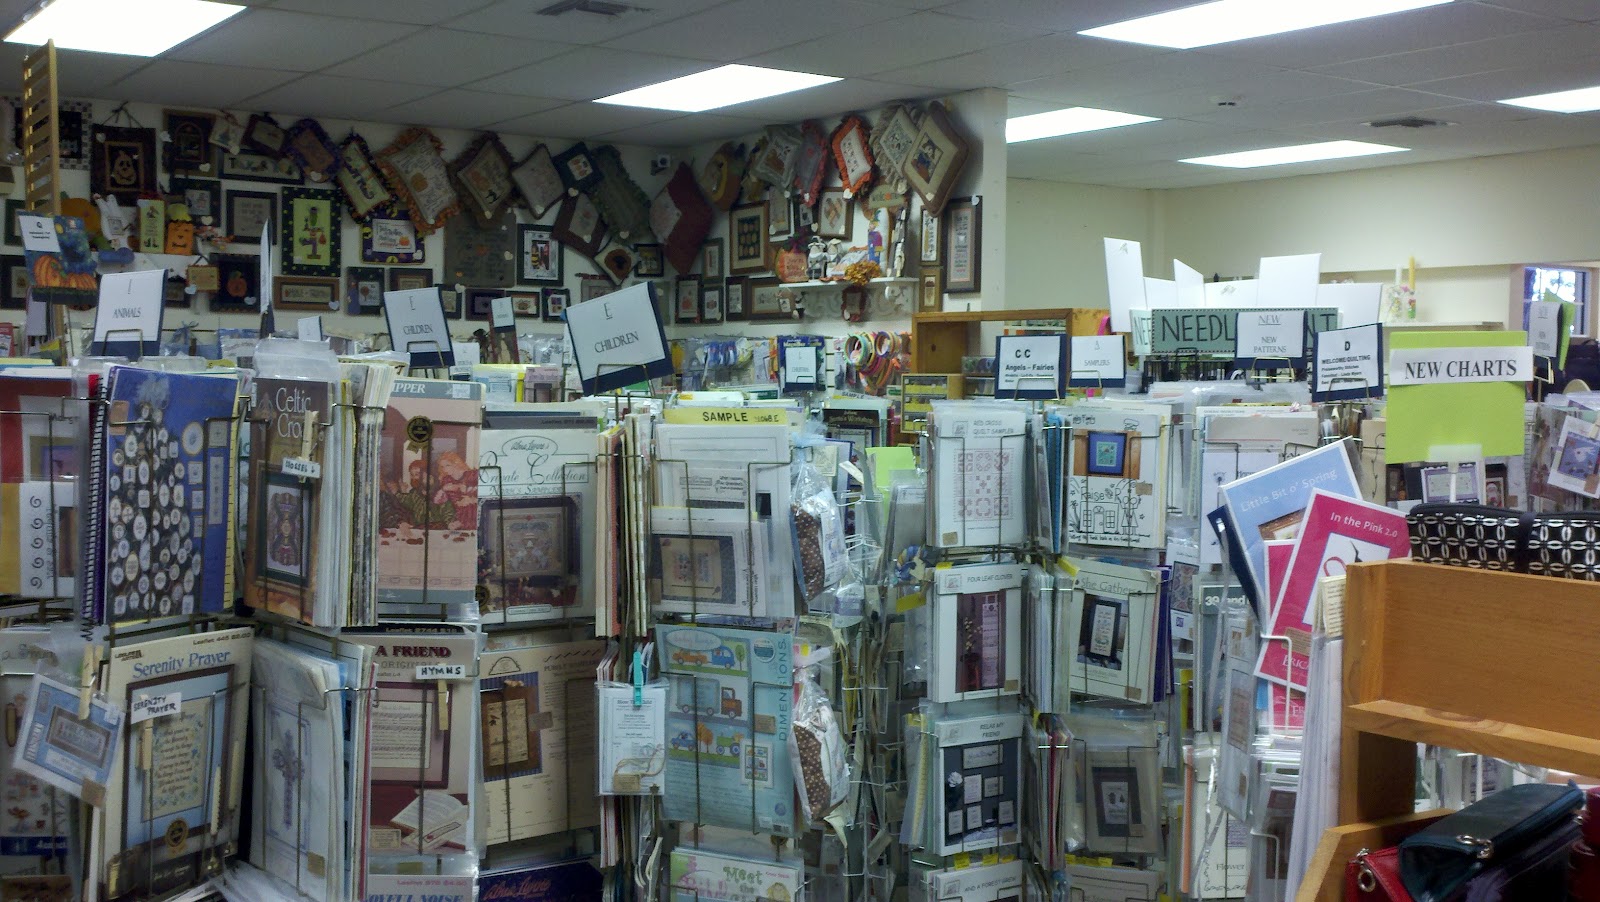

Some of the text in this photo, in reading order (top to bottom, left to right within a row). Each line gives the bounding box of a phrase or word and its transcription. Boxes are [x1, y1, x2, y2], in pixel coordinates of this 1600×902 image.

[112, 307, 142, 319] ANIMALS
[1258, 314, 1282, 325] NEW
[402, 324, 434, 335] CHILDREN
[594, 331, 639, 354] CHILDREN
[1261, 336, 1277, 344] NEW
[1344, 341, 1351, 351] D
[1253, 346, 1287, 354] PATTERNS
[1006, 364, 1026, 372] Angels
[1032, 363, 1055, 371] Fairies
[1084, 359, 1111, 367] SAMPLERS
[1405, 359, 1518, 380] NEW CHARTS
[276, 387, 313, 413] Celtic
[702, 411, 749, 422] SAMPLE
[1241, 496, 1270, 512] Little
[1271, 488, 1288, 500] Bit
[1302, 470, 1338, 489] Spring
[1330, 511, 1399, 538] In the Pink 2.0
[1081, 577, 1099, 590] She
[375, 645, 452, 659] A FRIEND
[133, 651, 231, 678] Serenity Prayer
[421, 666, 461, 676] HYMNS
[133, 695, 167, 712] SERENITY
[147, 702, 177, 715] PRAYER
[723, 866, 763, 885] Meet
